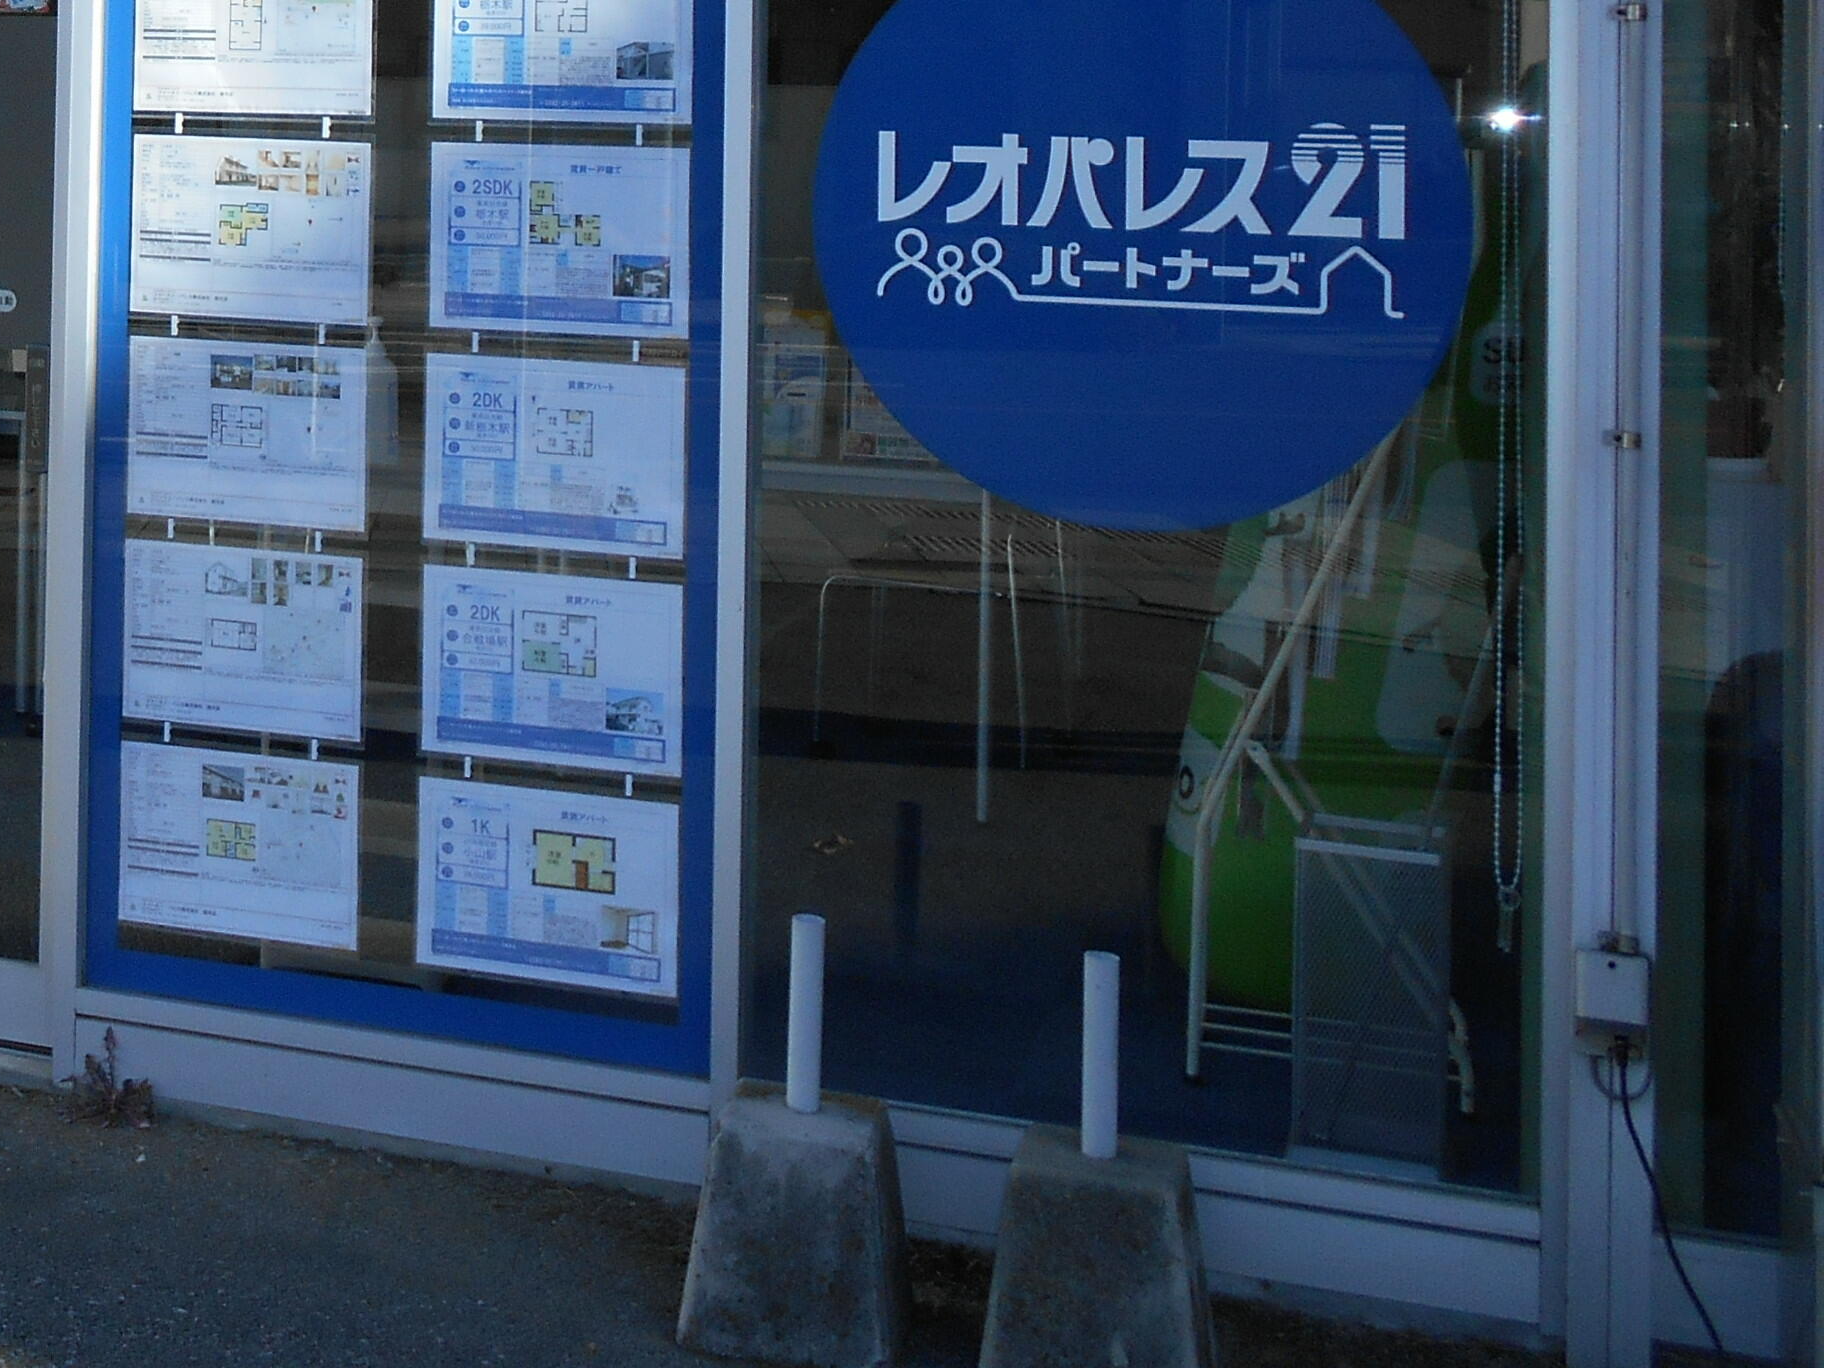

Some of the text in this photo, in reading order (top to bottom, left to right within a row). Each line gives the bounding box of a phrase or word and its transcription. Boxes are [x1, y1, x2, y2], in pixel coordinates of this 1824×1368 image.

[472, 178, 514, 195] 2SDK
[877, 122, 1406, 241] レオパレス21
[1031, 242, 1307, 295] パートナーズ
[472, 392, 503, 410] 2DK
[470, 604, 501, 622] 2DK
[471, 817, 490, 834] 1K
